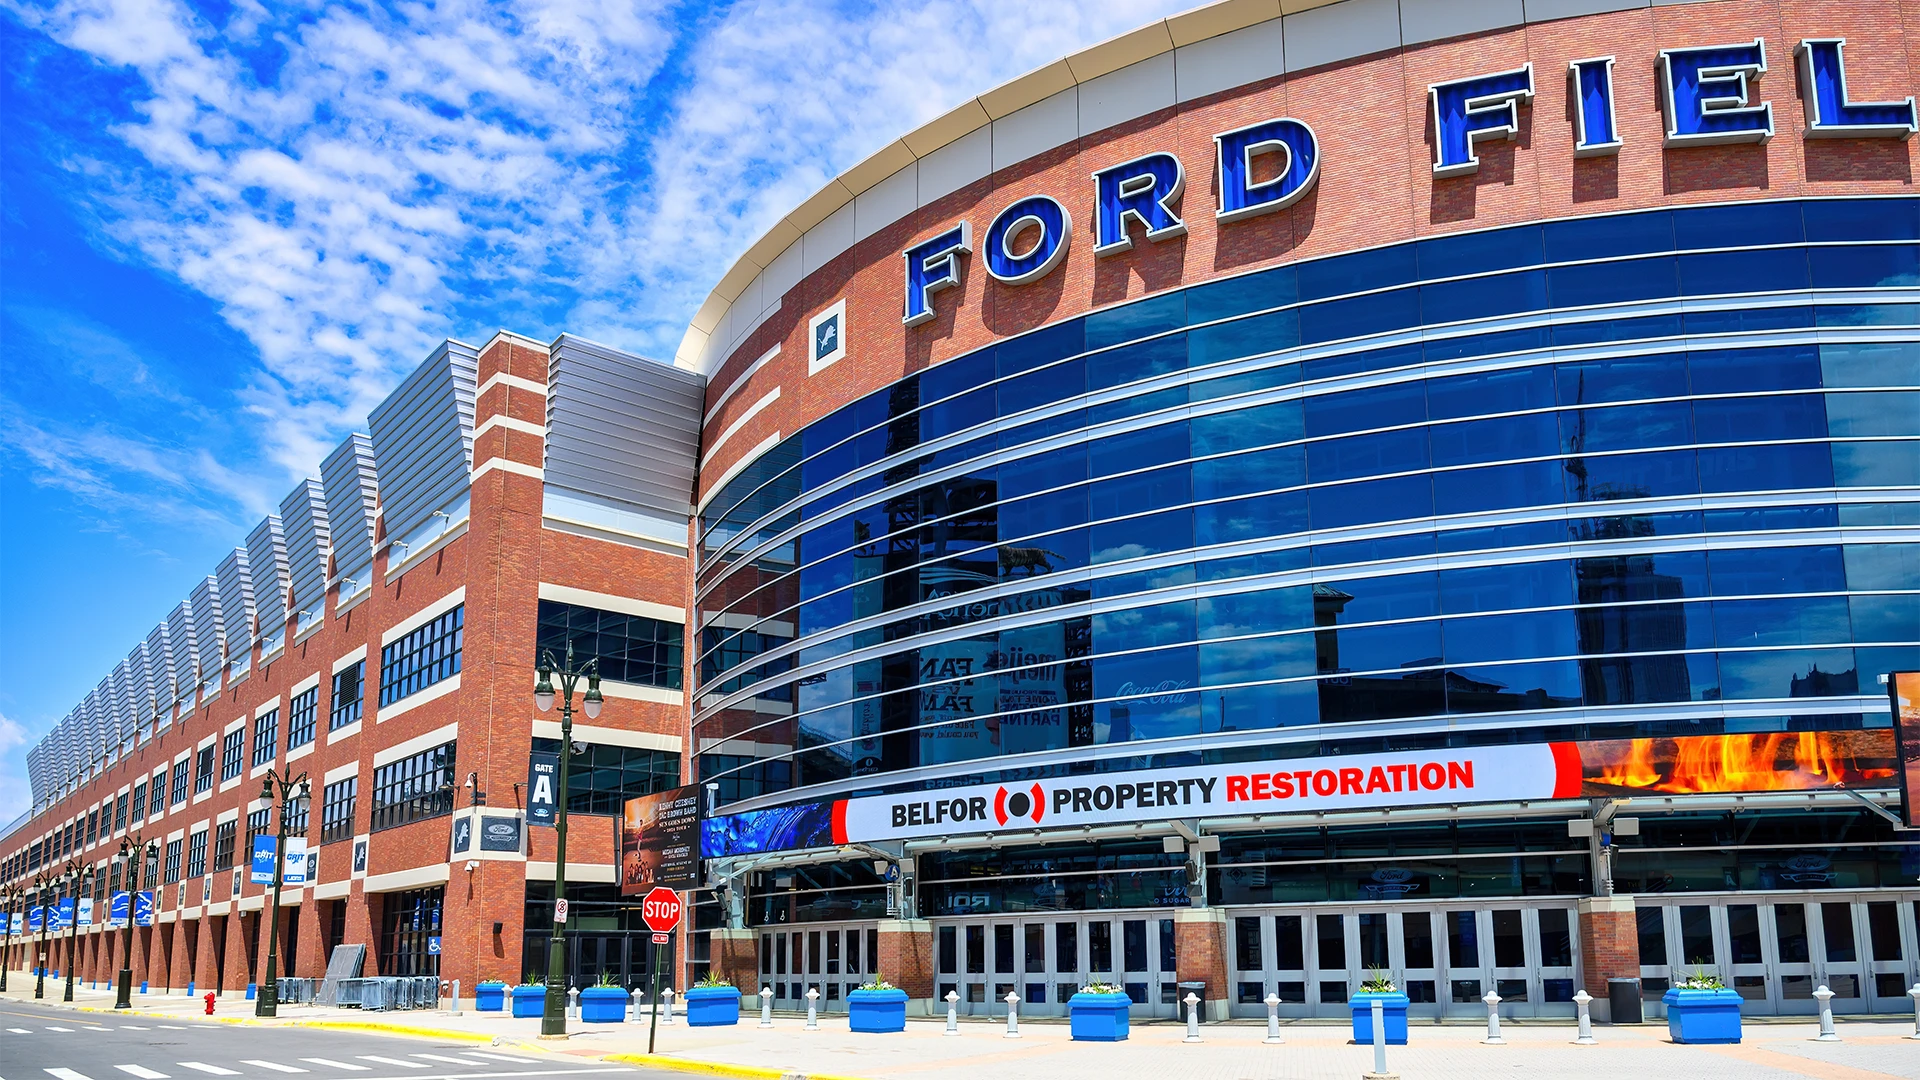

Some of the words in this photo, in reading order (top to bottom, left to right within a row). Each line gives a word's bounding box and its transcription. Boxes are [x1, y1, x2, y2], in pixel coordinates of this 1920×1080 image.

[902, 117, 1322, 328] FORD
[1427, 37, 1919, 180] FIEL
[534, 763, 553, 773] GATE
[532, 775, 553, 804] A
[891, 796, 987, 828] BELFOR
[1053, 777, 1217, 814] PROPERTY
[1226, 760, 1474, 802] RESTORATION
[254, 850, 274, 860] GRIT
[287, 853, 305, 862] GRIT
[890, 866, 898, 878] A
[645, 900, 679, 919] STOP
